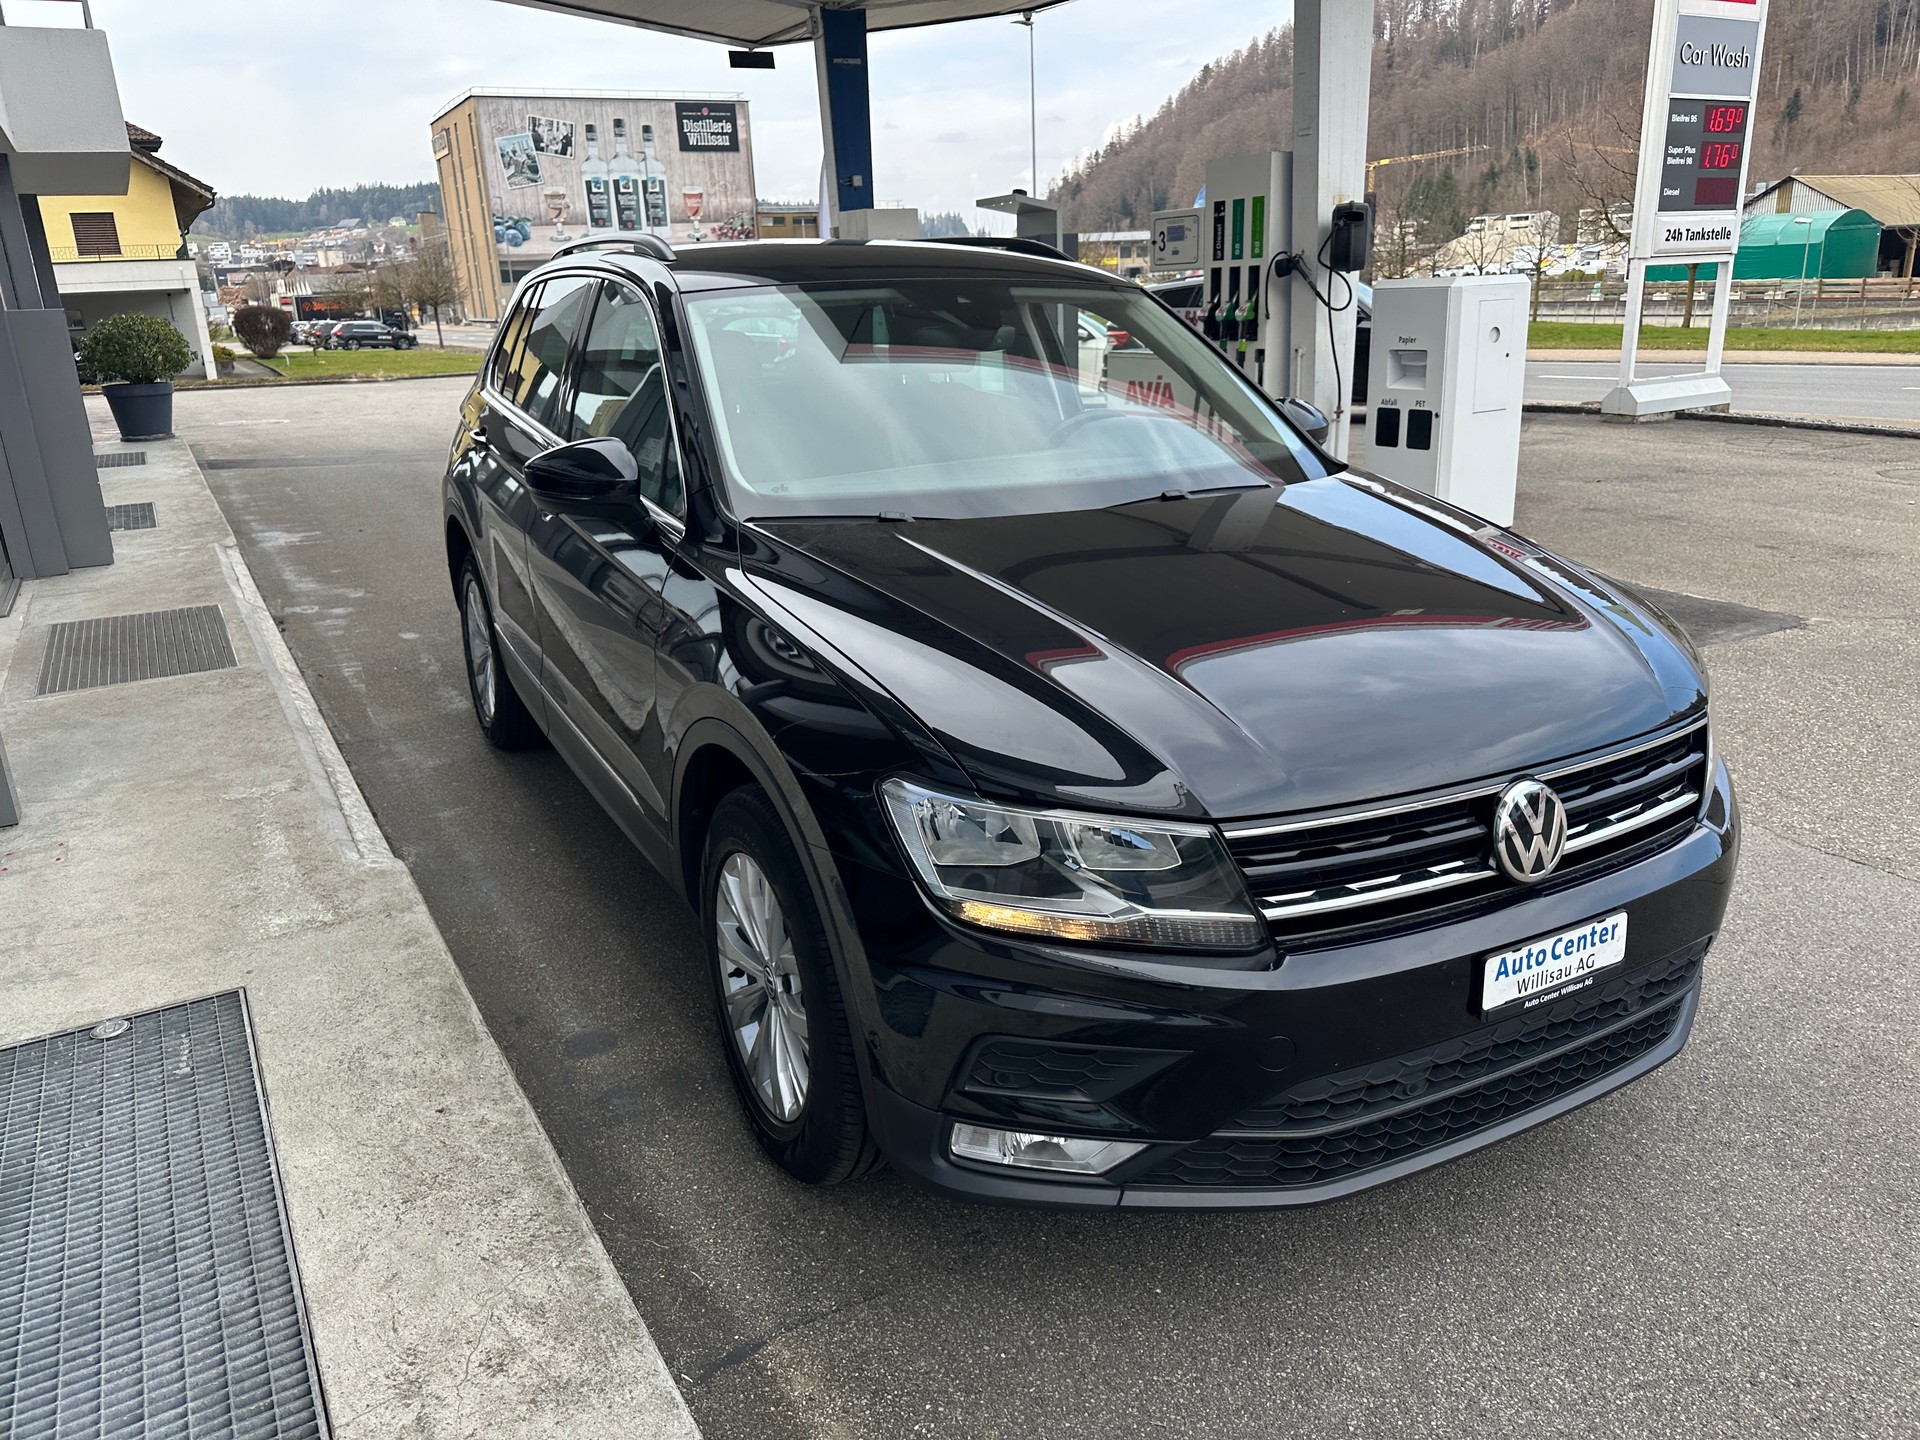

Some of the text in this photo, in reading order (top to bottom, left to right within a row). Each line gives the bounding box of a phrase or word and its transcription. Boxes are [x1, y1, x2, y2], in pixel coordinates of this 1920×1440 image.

[1680, 41, 1751, 68] Car Wash
[1671, 113, 1698, 123] Bleifrei 95
[682, 119, 732, 133] Distillerie
[686, 132, 730, 146] Willisau
[1667, 145, 1696, 155] Super Plus
[1666, 156, 1693, 165] Bleifrei 98
[1663, 187, 1680, 196] Diesel
[1158, 230, 1166, 252] 3
[1215, 223, 1223, 249] Diesel
[1664, 226, 1731, 242] 24h Tankstelle
[1398, 335, 1417, 345] Papier
[1415, 400, 1426, 408] PET
[1517, 953, 1596, 995] Willisau AG
[1524, 976, 1594, 1009] Auto Center Willisau AG
